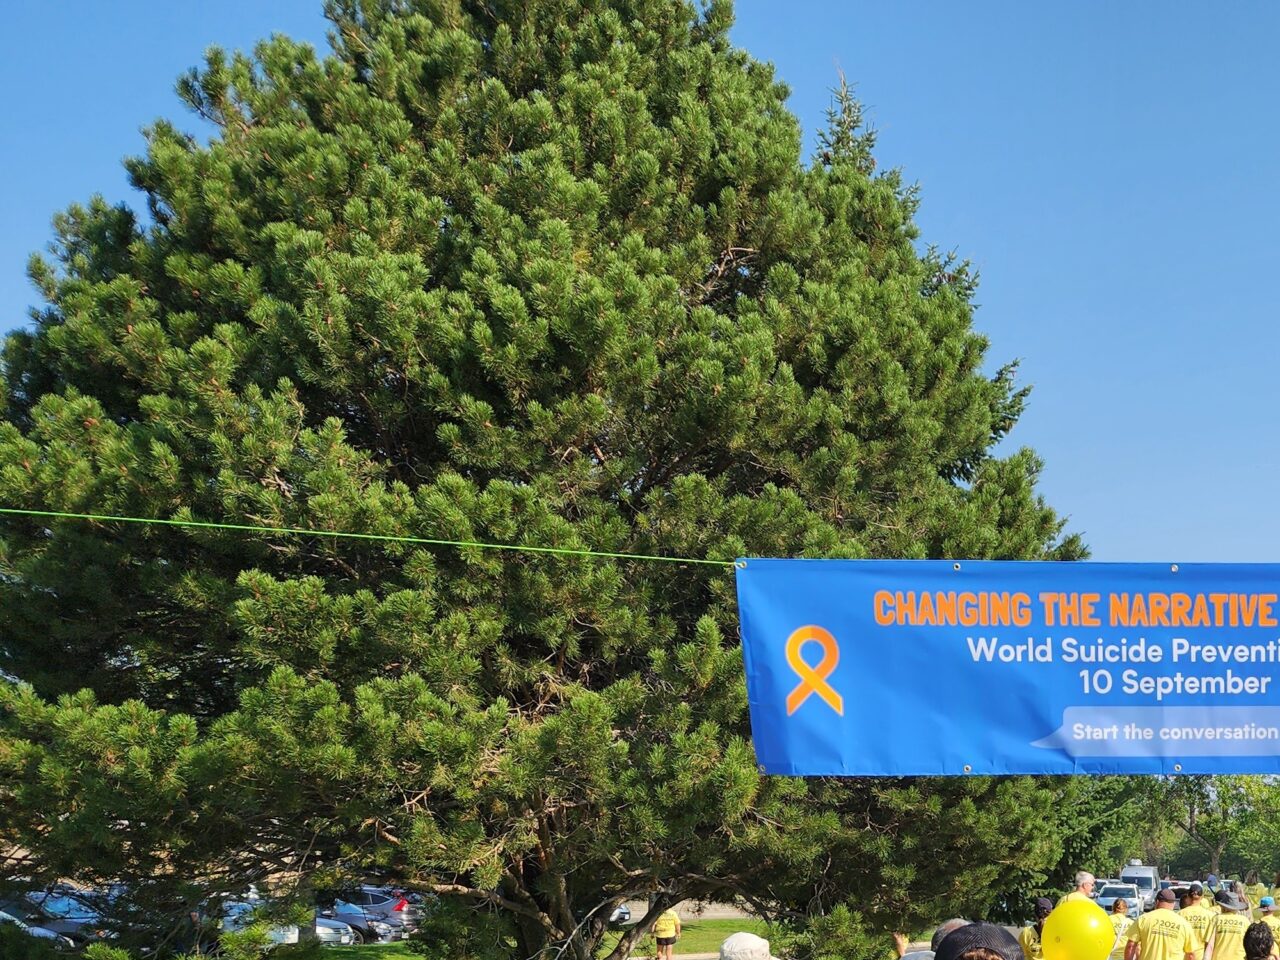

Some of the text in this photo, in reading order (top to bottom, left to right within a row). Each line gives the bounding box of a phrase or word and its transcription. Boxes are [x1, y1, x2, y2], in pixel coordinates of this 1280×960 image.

[873, 591, 1032, 627] CHANGING
[1038, 592, 1100, 627] THE
[1109, 593, 1278, 627] NARRATIVE
[966, 637, 1052, 662] World
[1061, 638, 1162, 662] Suicide
[1079, 669, 1271, 700] 10 September
[1072, 723, 1279, 740] Start the conversation
[1160, 920, 1181, 930] 2024
